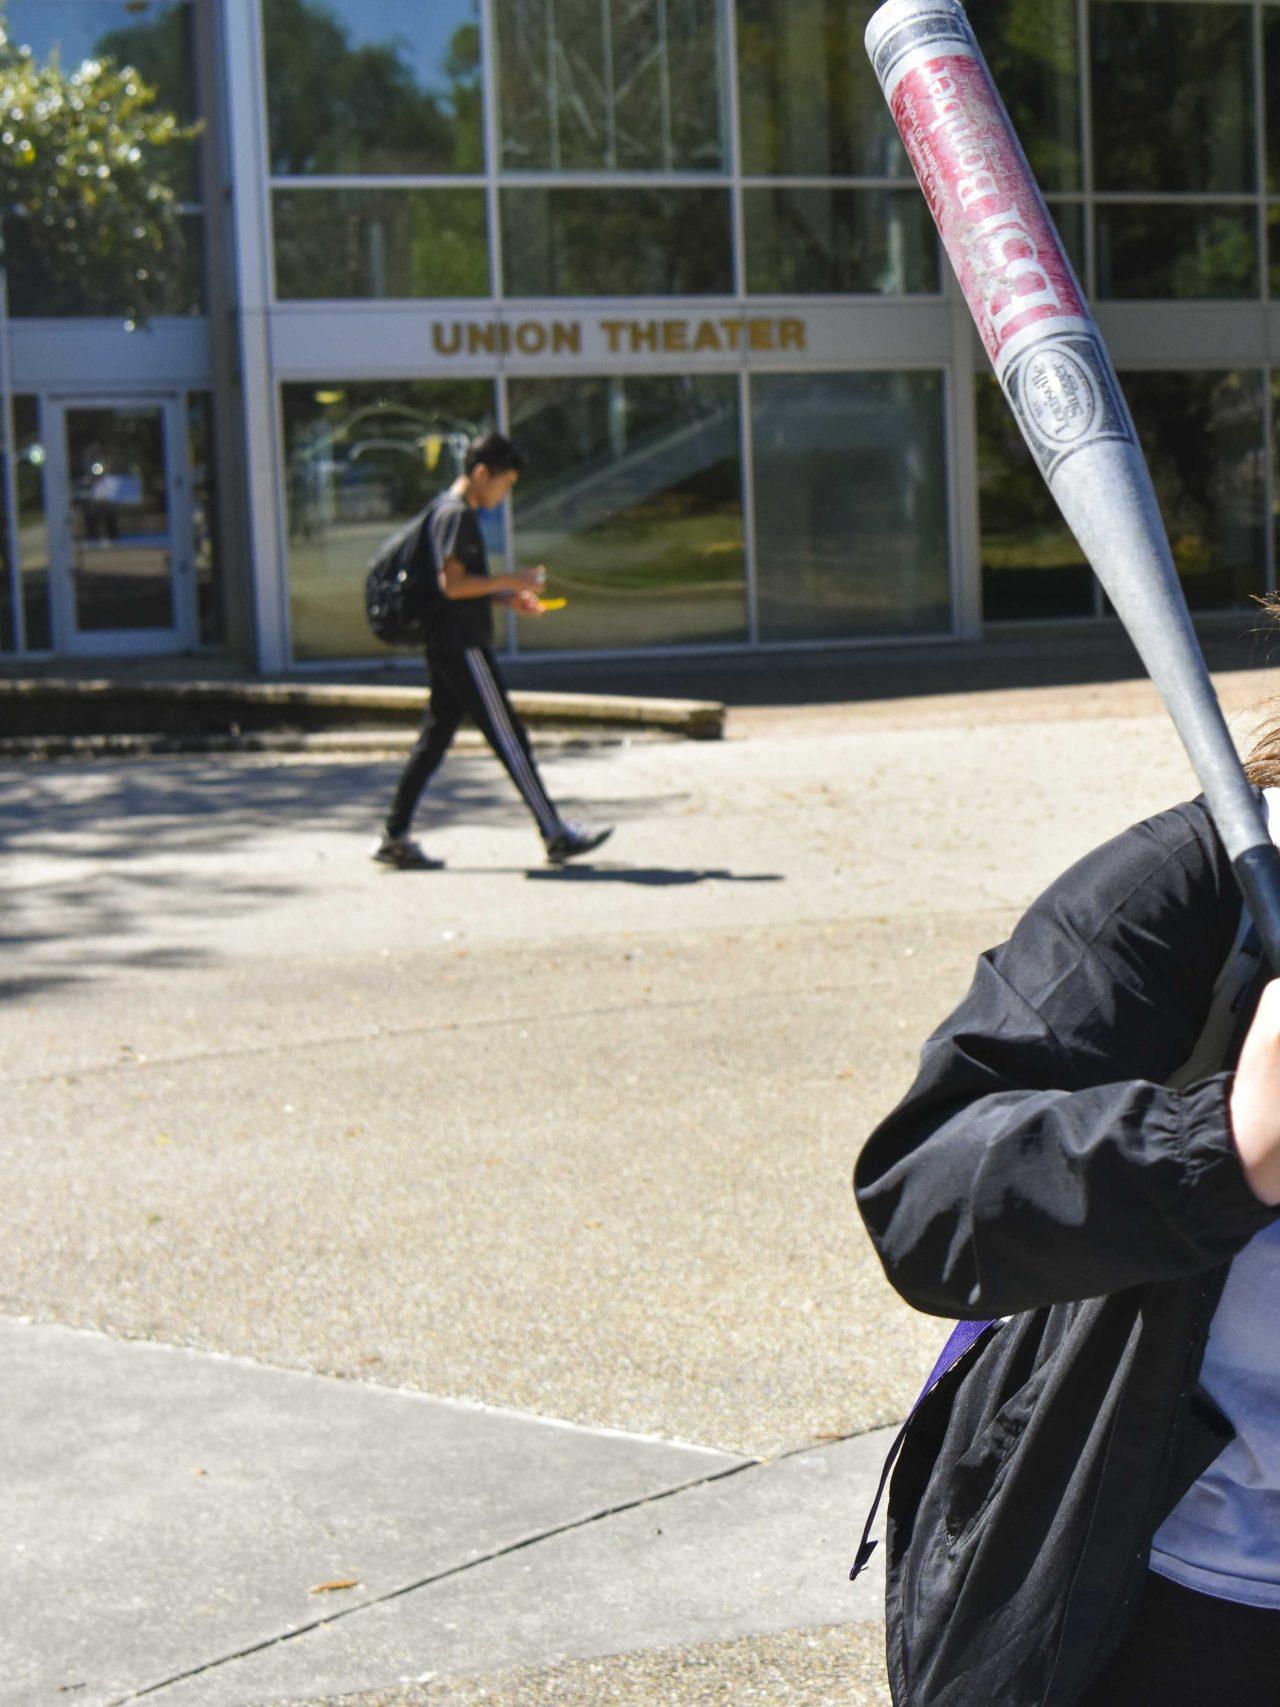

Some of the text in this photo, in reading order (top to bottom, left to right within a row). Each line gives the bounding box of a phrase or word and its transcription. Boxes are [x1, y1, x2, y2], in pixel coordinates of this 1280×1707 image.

[917, 65, 1000, 211] Bomber
[431, 317, 809, 355] UNION THEATER
[1031, 361, 1070, 436] Louisville
[1053, 360, 1084, 418] Slugger
